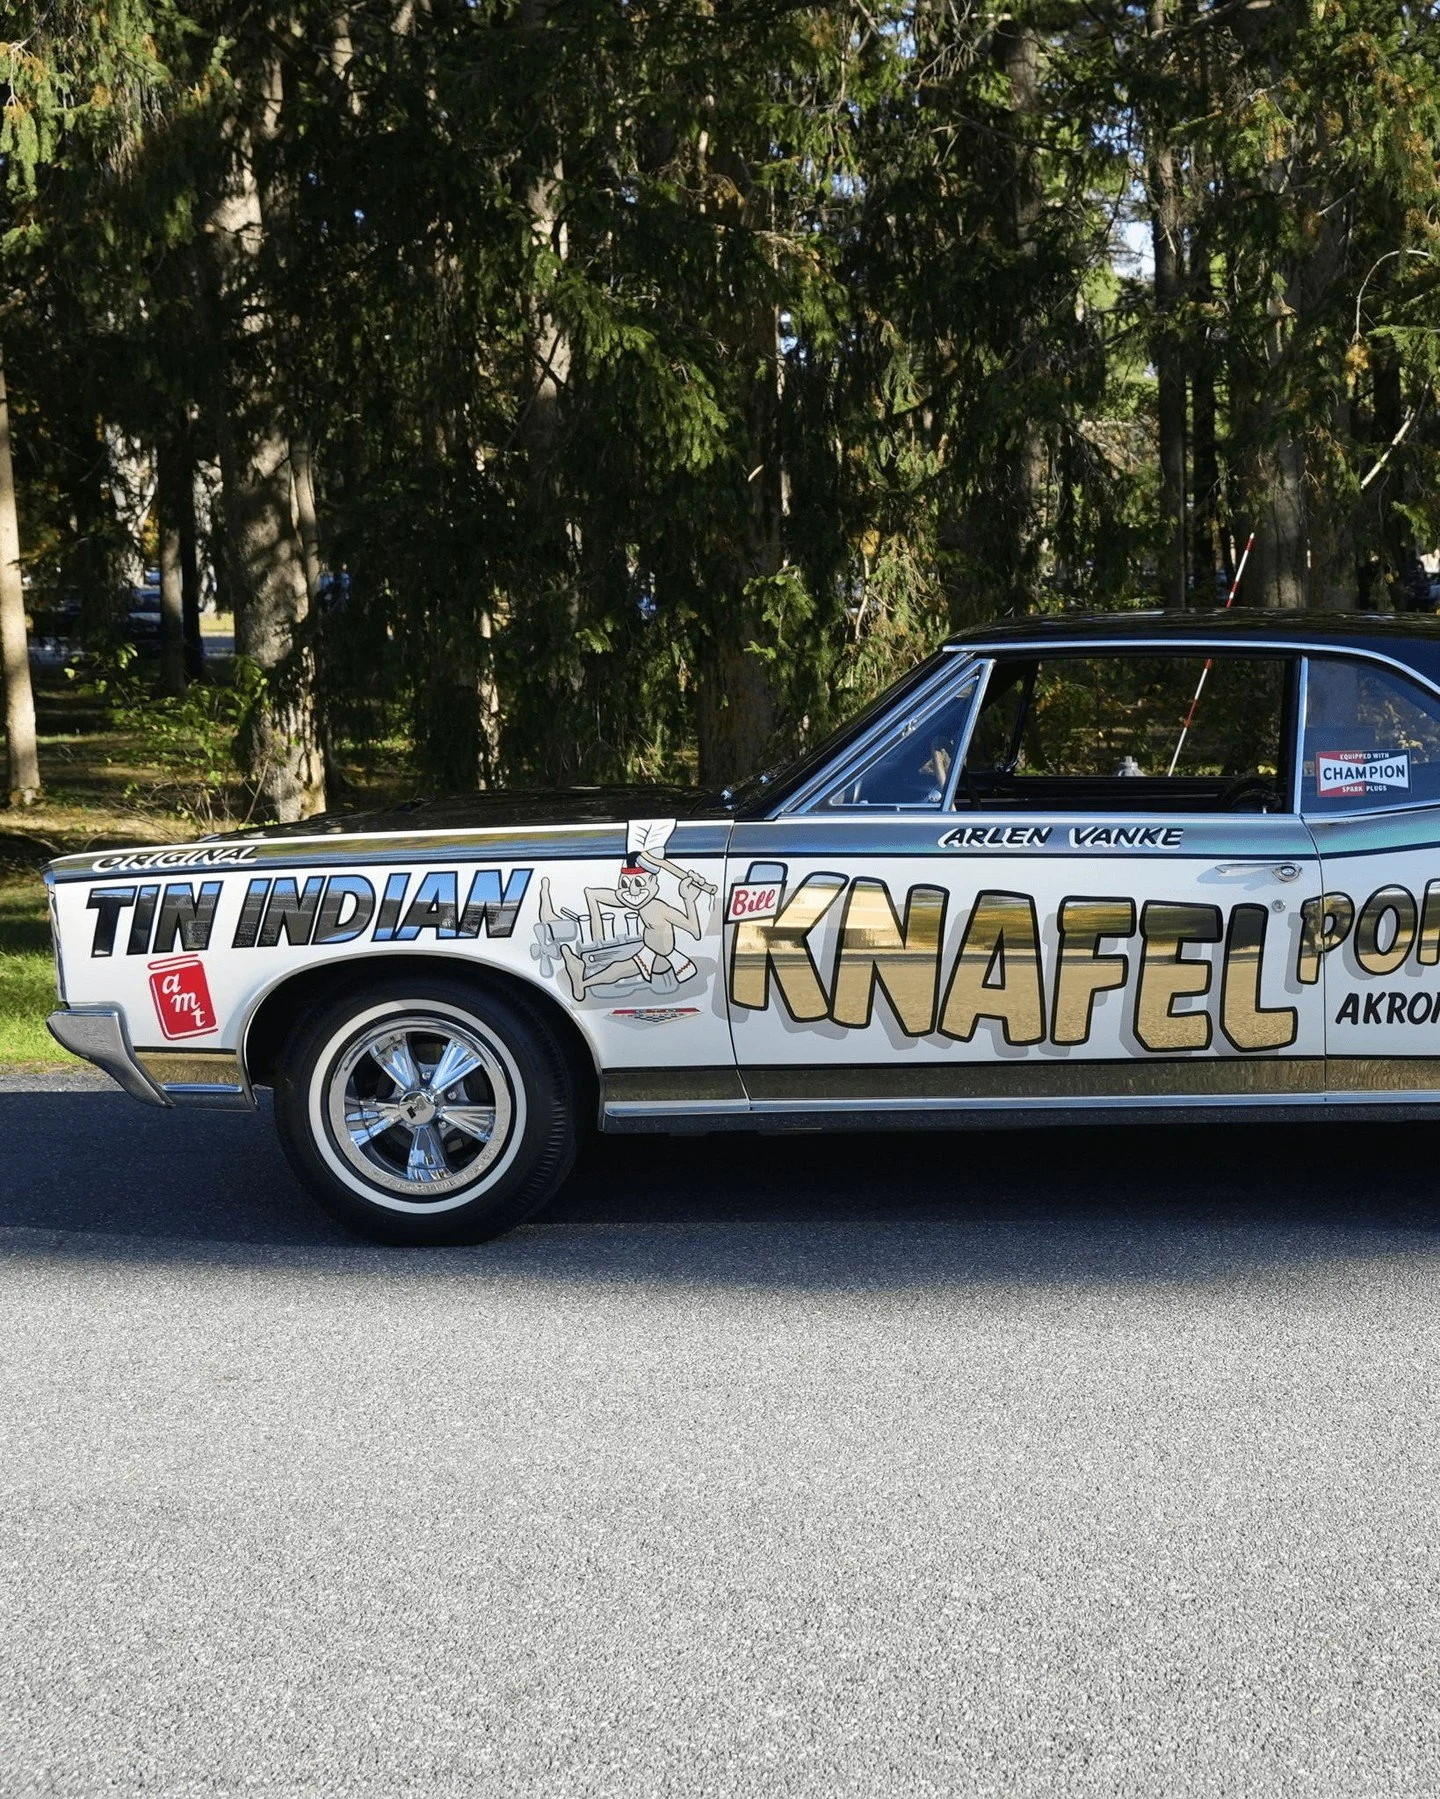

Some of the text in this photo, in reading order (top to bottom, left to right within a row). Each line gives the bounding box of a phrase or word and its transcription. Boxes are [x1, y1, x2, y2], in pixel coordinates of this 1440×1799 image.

[1340, 752, 1390, 761] EQUIPPED WITH
[1323, 764, 1405, 781] CHAMPION
[1342, 785, 1363, 793] SPARK
[938, 826, 1184, 849] ARLEN VANKE
[92, 846, 257, 873] ORIGINAL
[86, 868, 534, 958] TIN INDIAN
[732, 888, 776, 916] Bill
[729, 860, 1298, 1052] KNAFEL
[162, 973, 206, 1027] amt
